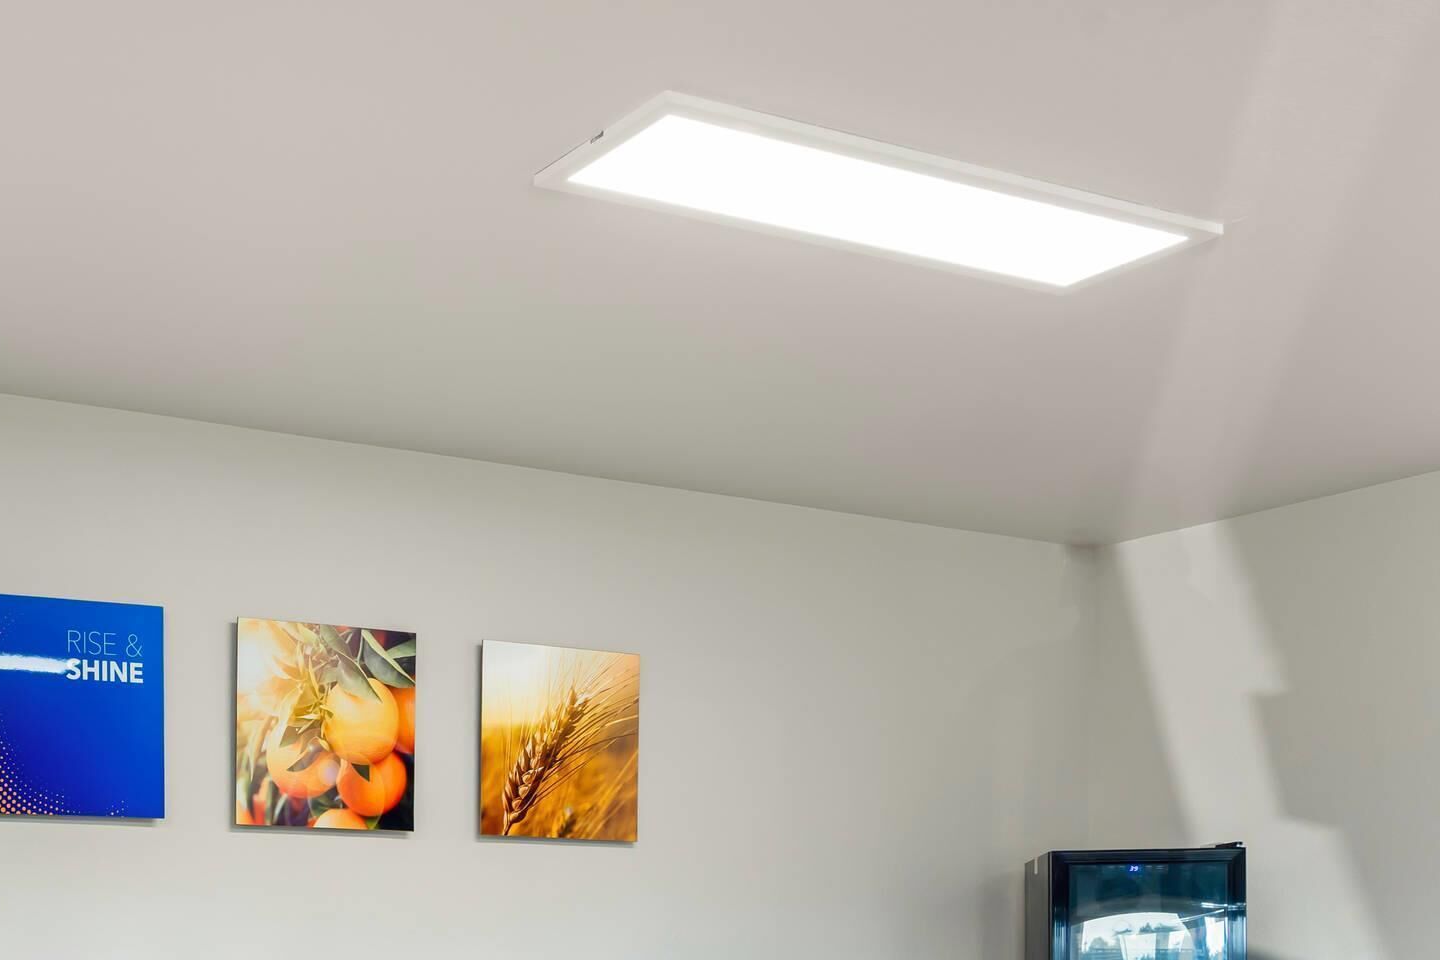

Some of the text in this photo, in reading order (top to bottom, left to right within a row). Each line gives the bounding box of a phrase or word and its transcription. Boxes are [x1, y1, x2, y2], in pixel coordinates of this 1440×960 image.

[67, 630, 143, 658] RISE &
[66, 658, 144, 684] SHINE
